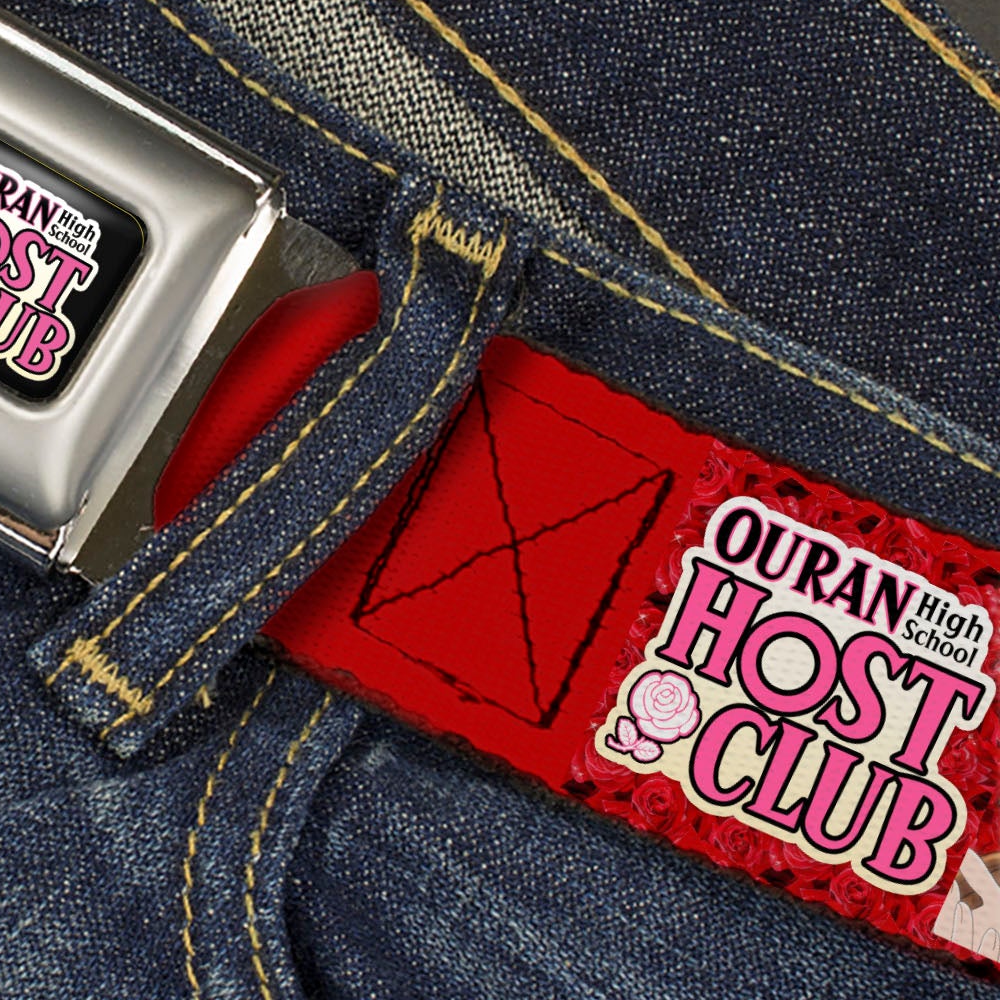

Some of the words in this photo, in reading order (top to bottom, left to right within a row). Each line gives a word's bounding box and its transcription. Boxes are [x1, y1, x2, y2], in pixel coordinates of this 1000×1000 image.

[48, 224, 91, 256] School
[56, 209, 96, 243] High
[714, 506, 920, 634] OURAN
[915, 591, 985, 644] High
[655, 556, 986, 776] HOST
[901, 620, 979, 668] School
[688, 702, 958, 885] CLUB
